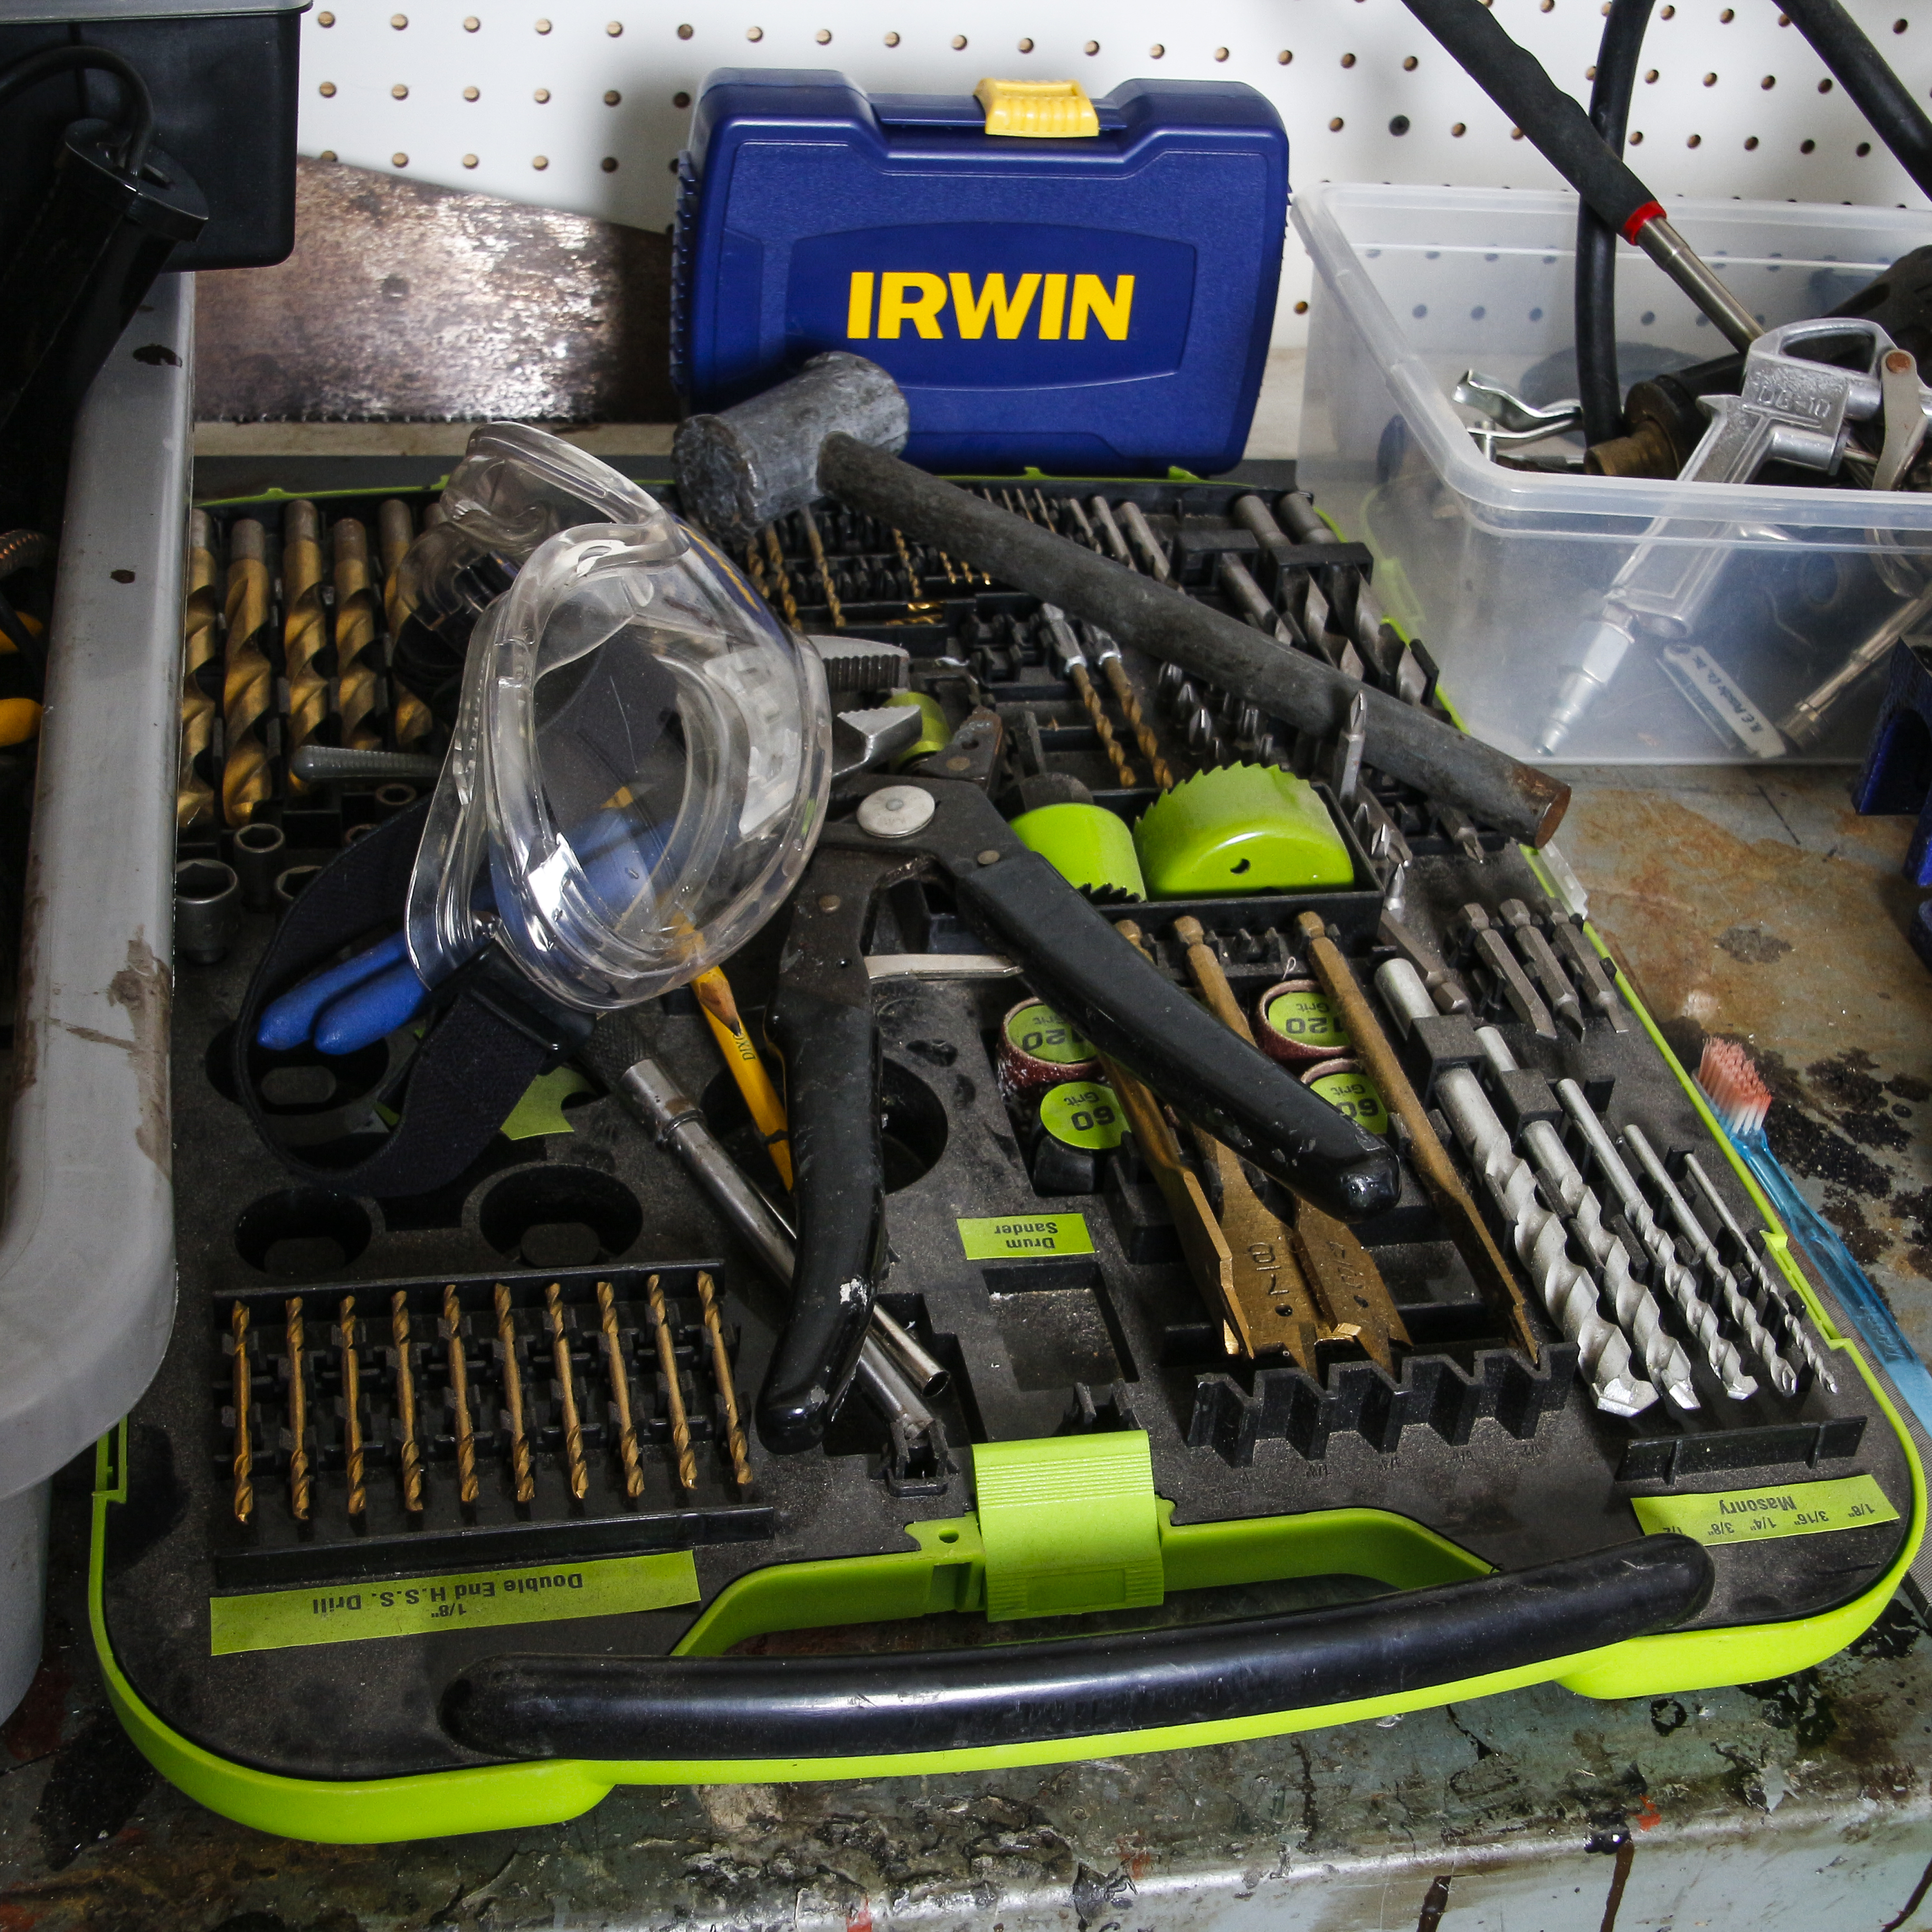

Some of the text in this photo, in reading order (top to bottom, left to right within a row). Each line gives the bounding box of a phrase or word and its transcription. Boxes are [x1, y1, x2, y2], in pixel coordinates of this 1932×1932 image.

[846, 271, 1135, 341] IRWIN
[1296, 1002, 1330, 1013] Grit
[1285, 1016, 1344, 1035] 120
[1063, 1090, 1100, 1108] Grit
[1329, 1084, 1366, 1101] Grit
[1072, 1105, 1116, 1132] 60
[994, 1221, 1059, 1236] Sander
[1005, 1237, 1055, 1250] Drum
[1718, 1495, 1797, 1516] Masonry
[1847, 1502, 1875, 1518] 1/8"
[1749, 1515, 1777, 1531] 1/4"
[1793, 1509, 1829, 1526] 3/16"
[1707, 1521, 1733, 1537] 3/8"
[312, 1572, 583, 1615] Double End H.S.S. Drill
[430, 1602, 468, 1619] 1/8"
